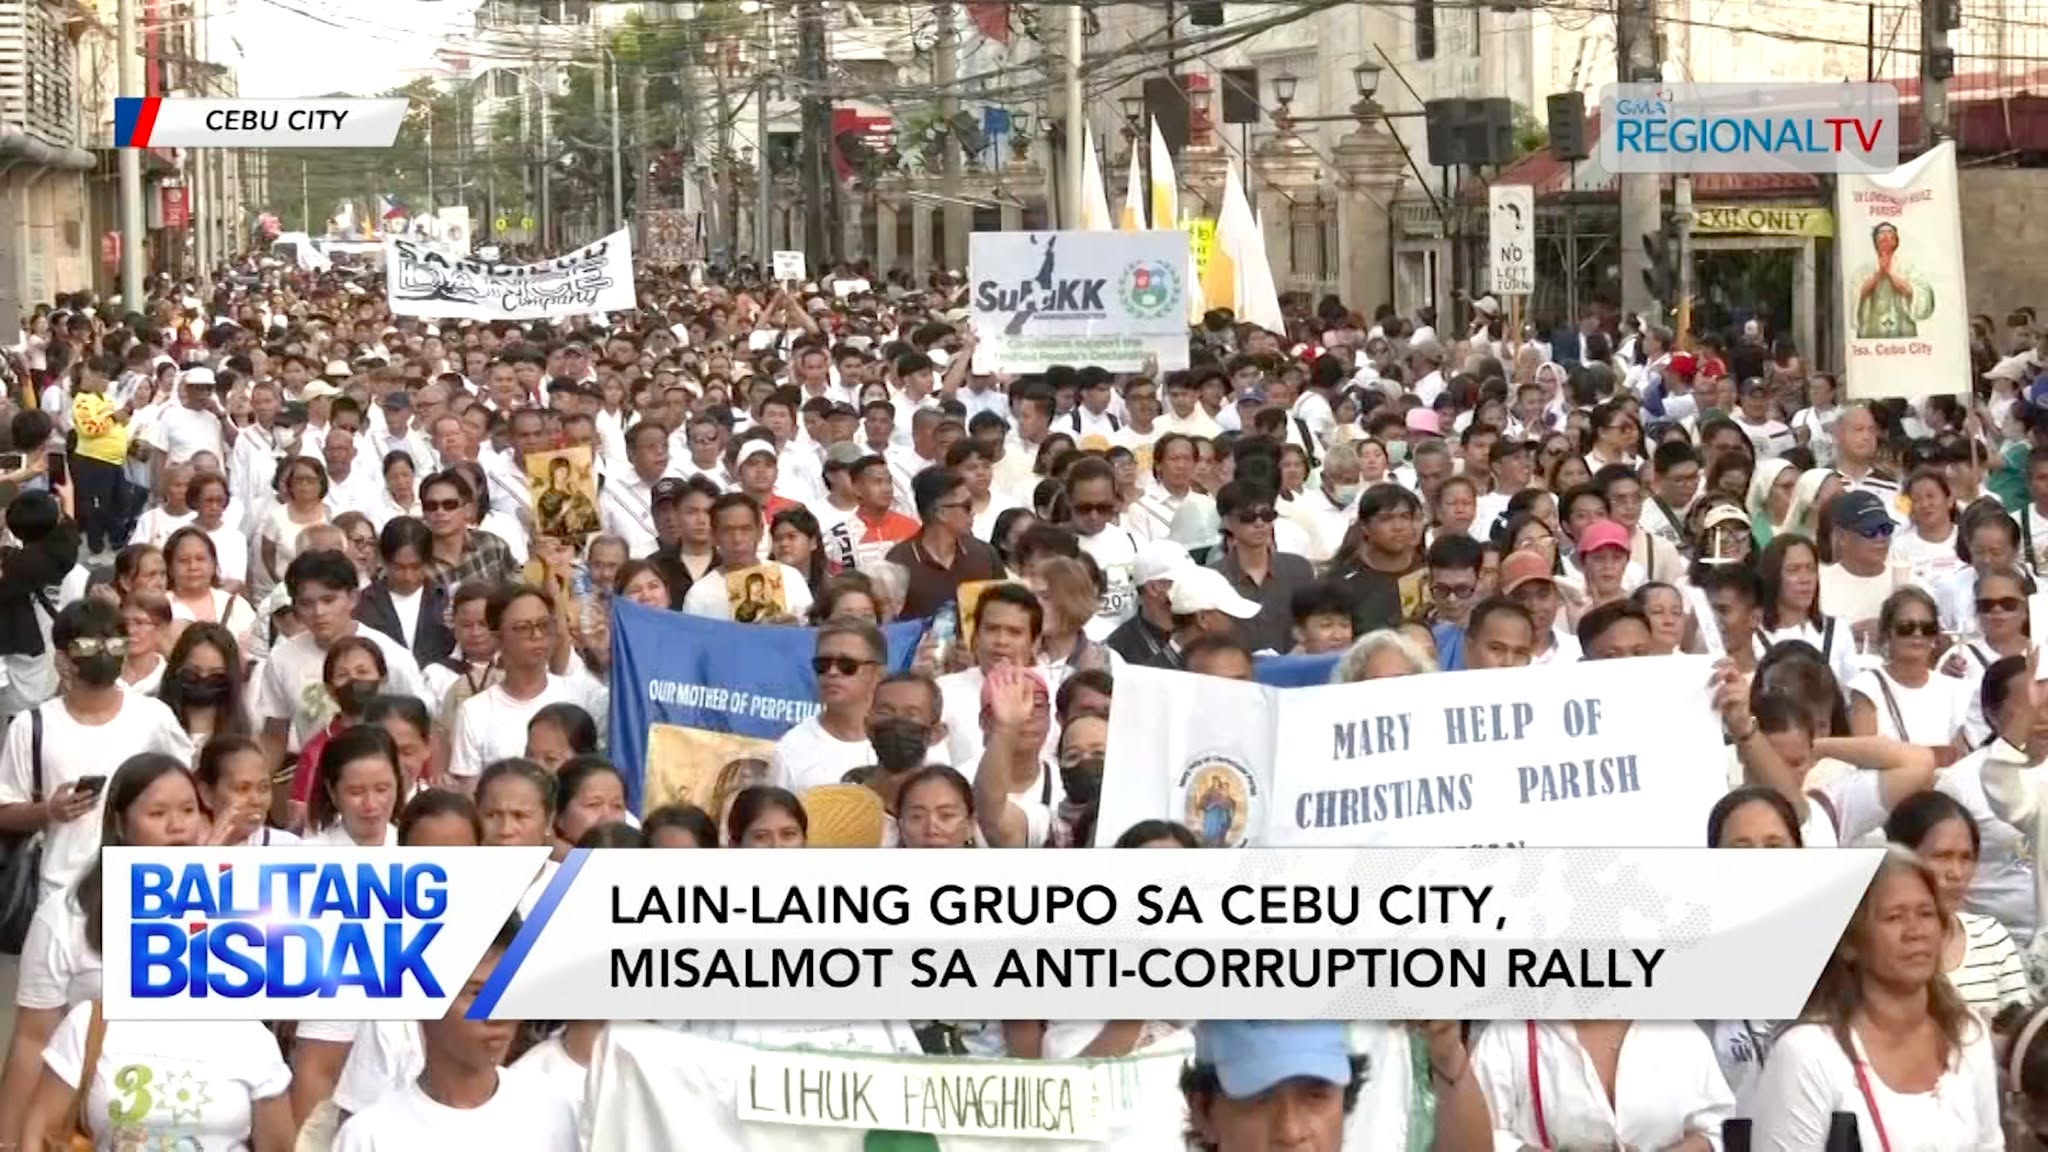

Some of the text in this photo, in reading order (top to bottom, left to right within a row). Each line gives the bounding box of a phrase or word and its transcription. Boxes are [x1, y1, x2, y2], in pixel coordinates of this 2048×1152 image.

[1747, 209, 1808, 230] ONLY
[1501, 247, 1523, 263] NO
[1496, 266, 1528, 278] LEFT
[1497, 279, 1532, 291] TURN
[1908, 342, 1933, 356] City
[649, 679, 676, 704] OUR
[676, 683, 728, 710] MOTHER
[730, 692, 749, 715] OF
[1332, 698, 1602, 761] MARY HELP OF
[1295, 772, 1474, 830] CHRISTIANS
[1517, 754, 1642, 804] PARISH
[750, 1064, 879, 1124] LIHUK
